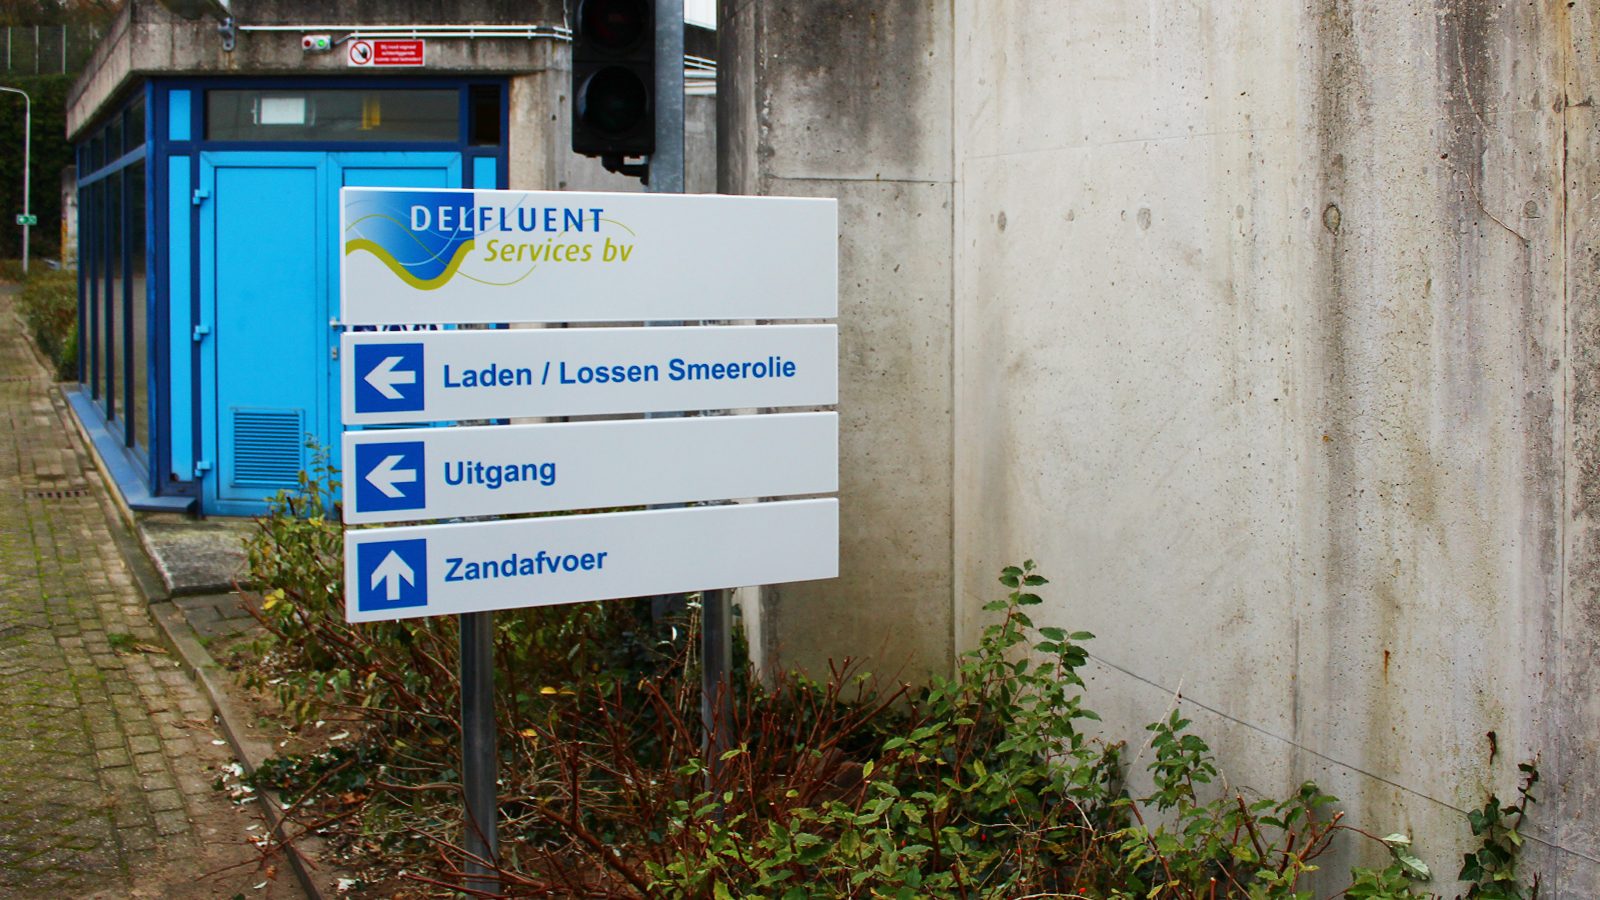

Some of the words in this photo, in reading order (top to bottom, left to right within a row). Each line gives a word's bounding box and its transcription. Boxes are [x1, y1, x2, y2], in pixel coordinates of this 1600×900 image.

[411, 205, 604, 232] DELFLUENT
[484, 238, 593, 262] Services
[602, 237, 634, 262] bv
[443, 363, 532, 388] Laden
[541, 361, 550, 385] /
[560, 361, 659, 384] Lossen
[668, 356, 796, 381] Smeerolie
[444, 461, 556, 490] Uitgang
[444, 551, 608, 582] Zandafvoer
